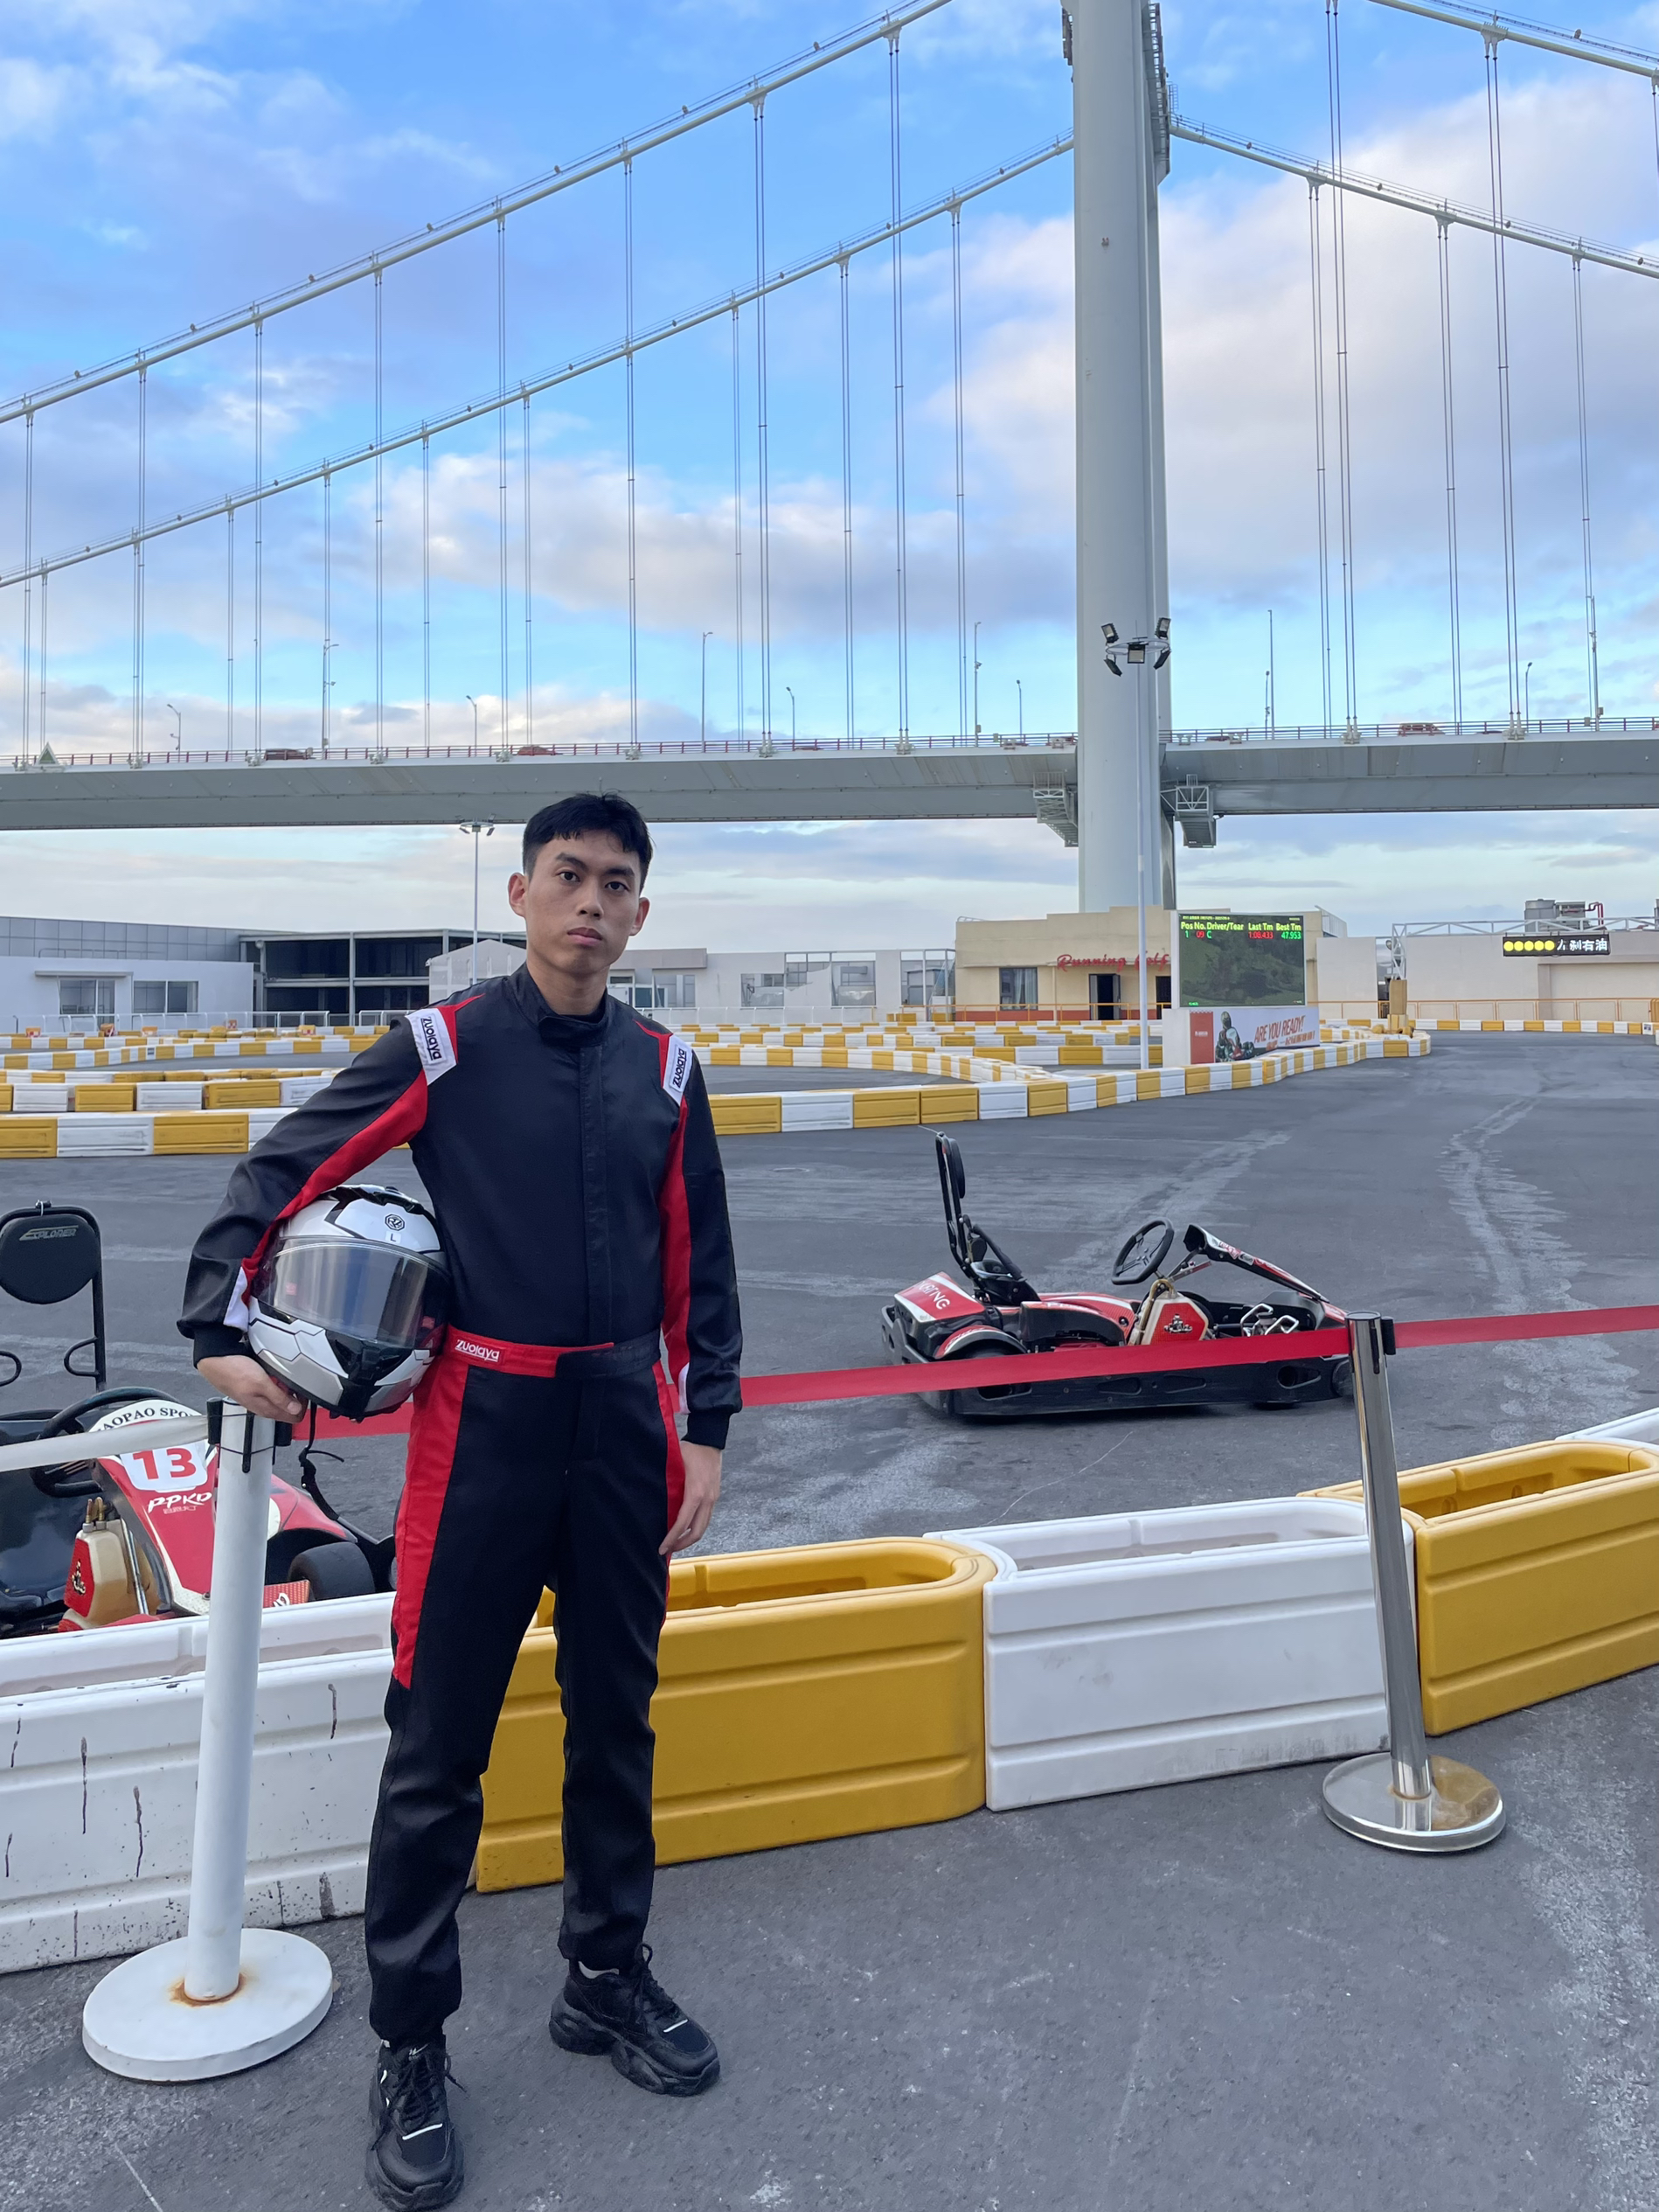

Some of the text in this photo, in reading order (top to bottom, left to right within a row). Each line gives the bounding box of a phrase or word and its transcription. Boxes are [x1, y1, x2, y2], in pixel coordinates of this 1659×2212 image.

[1181, 922, 1193, 930] Pos
[1194, 922, 1206, 930] No.
[1275, 922, 1290, 931] Best
[1281, 931, 1302, 940] 47.953
[1057, 954, 1126, 972] Running
[1254, 1025, 1268, 1043] ARE
[1268, 1020, 1282, 1040] YOU
[391, 1233, 396, 1242] L
[99, 1408, 192, 1431] AOPAO SPO
[132, 1447, 197, 1480] 13
